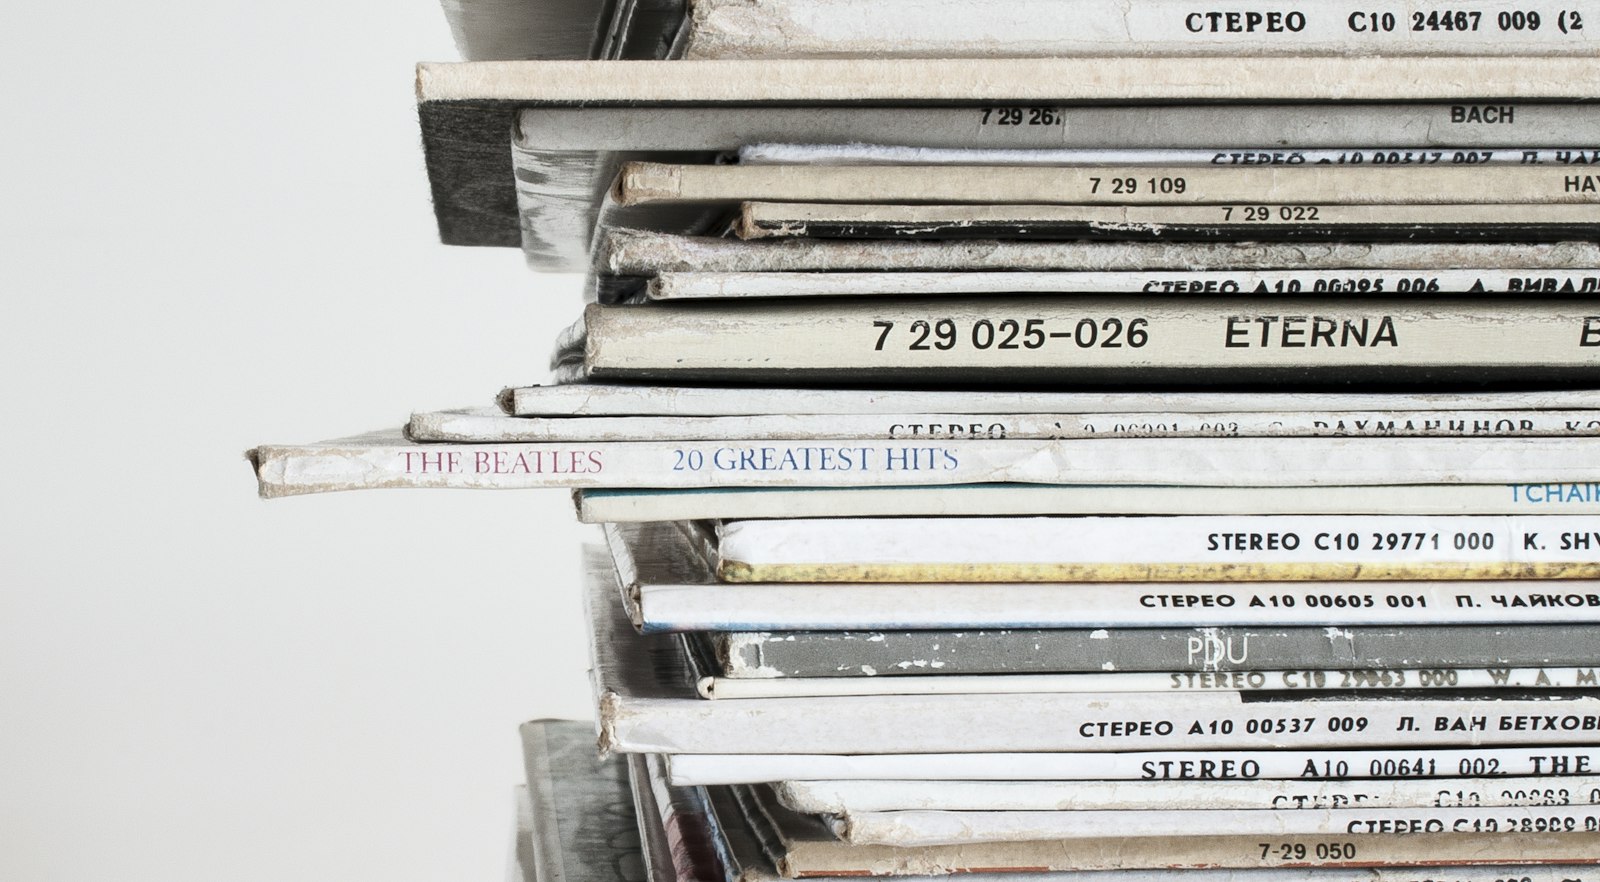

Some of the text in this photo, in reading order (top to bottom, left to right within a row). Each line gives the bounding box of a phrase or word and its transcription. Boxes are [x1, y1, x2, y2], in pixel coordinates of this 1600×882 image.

[1185, 11, 1306, 33] СТЕРЕО
[1412, 11, 1482, 32] 24467
[1497, 11, 1541, 31] 009
[1558, 10, 1583, 35] (2
[981, 108, 992, 125] 7
[998, 107, 1023, 125] 29
[1451, 106, 1514, 123] BACH
[1452, 151, 1493, 164] 007
[1089, 177, 1186, 194] 7 29 109
[1222, 207, 1320, 221] 7 29 022
[1143, 280, 1240, 293] СТЕРЕО
[1397, 278, 1440, 292] 006
[1508, 277, 1600, 293] ВИВАЛ
[873, 321, 894, 350] 7
[909, 319, 957, 350] 29
[1225, 315, 1399, 348] ETERNA
[399, 450, 603, 473] THE BEATLES
[673, 447, 959, 471] 20 GREATEST HITS
[1207, 532, 1301, 551] STEREO
[1314, 532, 1360, 551] C10
[1371, 532, 1440, 551] 29771
[1453, 532, 1495, 550] 000
[1523, 532, 1546, 550] K.
[1139, 595, 1236, 608] СТЕРЕО
[1305, 595, 1374, 608] 00605
[1386, 595, 1427, 608] 001
[1455, 595, 1482, 608] П.
[1188, 637, 1248, 665] PDU
[1171, 673, 1266, 689] STEREO
[1419, 670, 1459, 687] 000
[1079, 721, 1174, 737] СТЕРЕО
[1245, 719, 1316, 734] 00537
[1327, 717, 1369, 732] 009
[1396, 716, 1420, 731] Л.
[1434, 716, 1487, 731] ВАН
[1499, 715, 1600, 731] БЕТХОВ
[1142, 760, 1260, 778] STEREO
[1301, 759, 1348, 777] A10
[1369, 759, 1436, 776] 00641
[1529, 756, 1591, 775] THE
[1347, 819, 1444, 833] СТЕРЕО
[1258, 843, 1356, 859] 7-29 050
